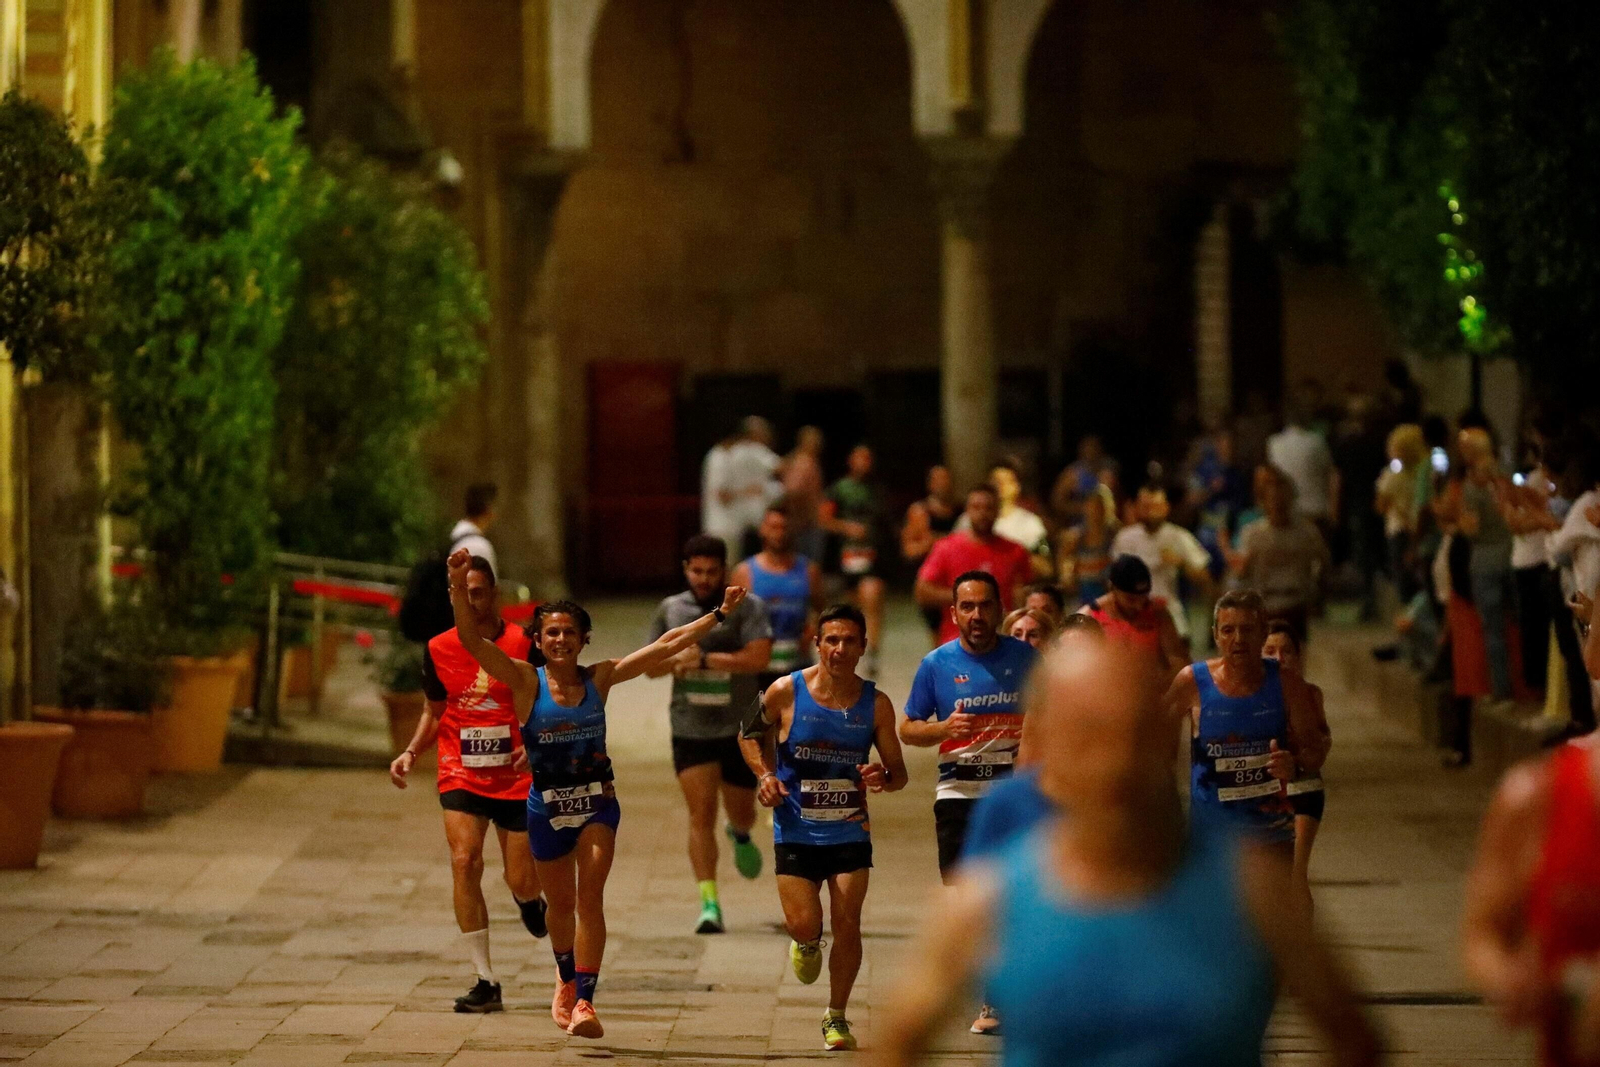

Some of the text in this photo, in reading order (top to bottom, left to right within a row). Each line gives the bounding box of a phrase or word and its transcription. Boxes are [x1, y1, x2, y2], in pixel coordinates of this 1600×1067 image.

[954, 692, 1019, 709] enerplus
[473, 729, 482, 738] 20
[538, 732, 554, 744] 20
[469, 739, 500, 752] 1192
[1207, 743, 1222, 757] 20
[794, 746, 811, 759] 20
[971, 755, 982, 764] 20
[1234, 760, 1246, 769] 20
[976, 765, 993, 777] 38
[1235, 769, 1263, 783] 856
[818, 782, 828, 791] 20
[560, 789, 571, 798] 20
[813, 792, 848, 805] 1240
[558, 797, 592, 812] 1241
